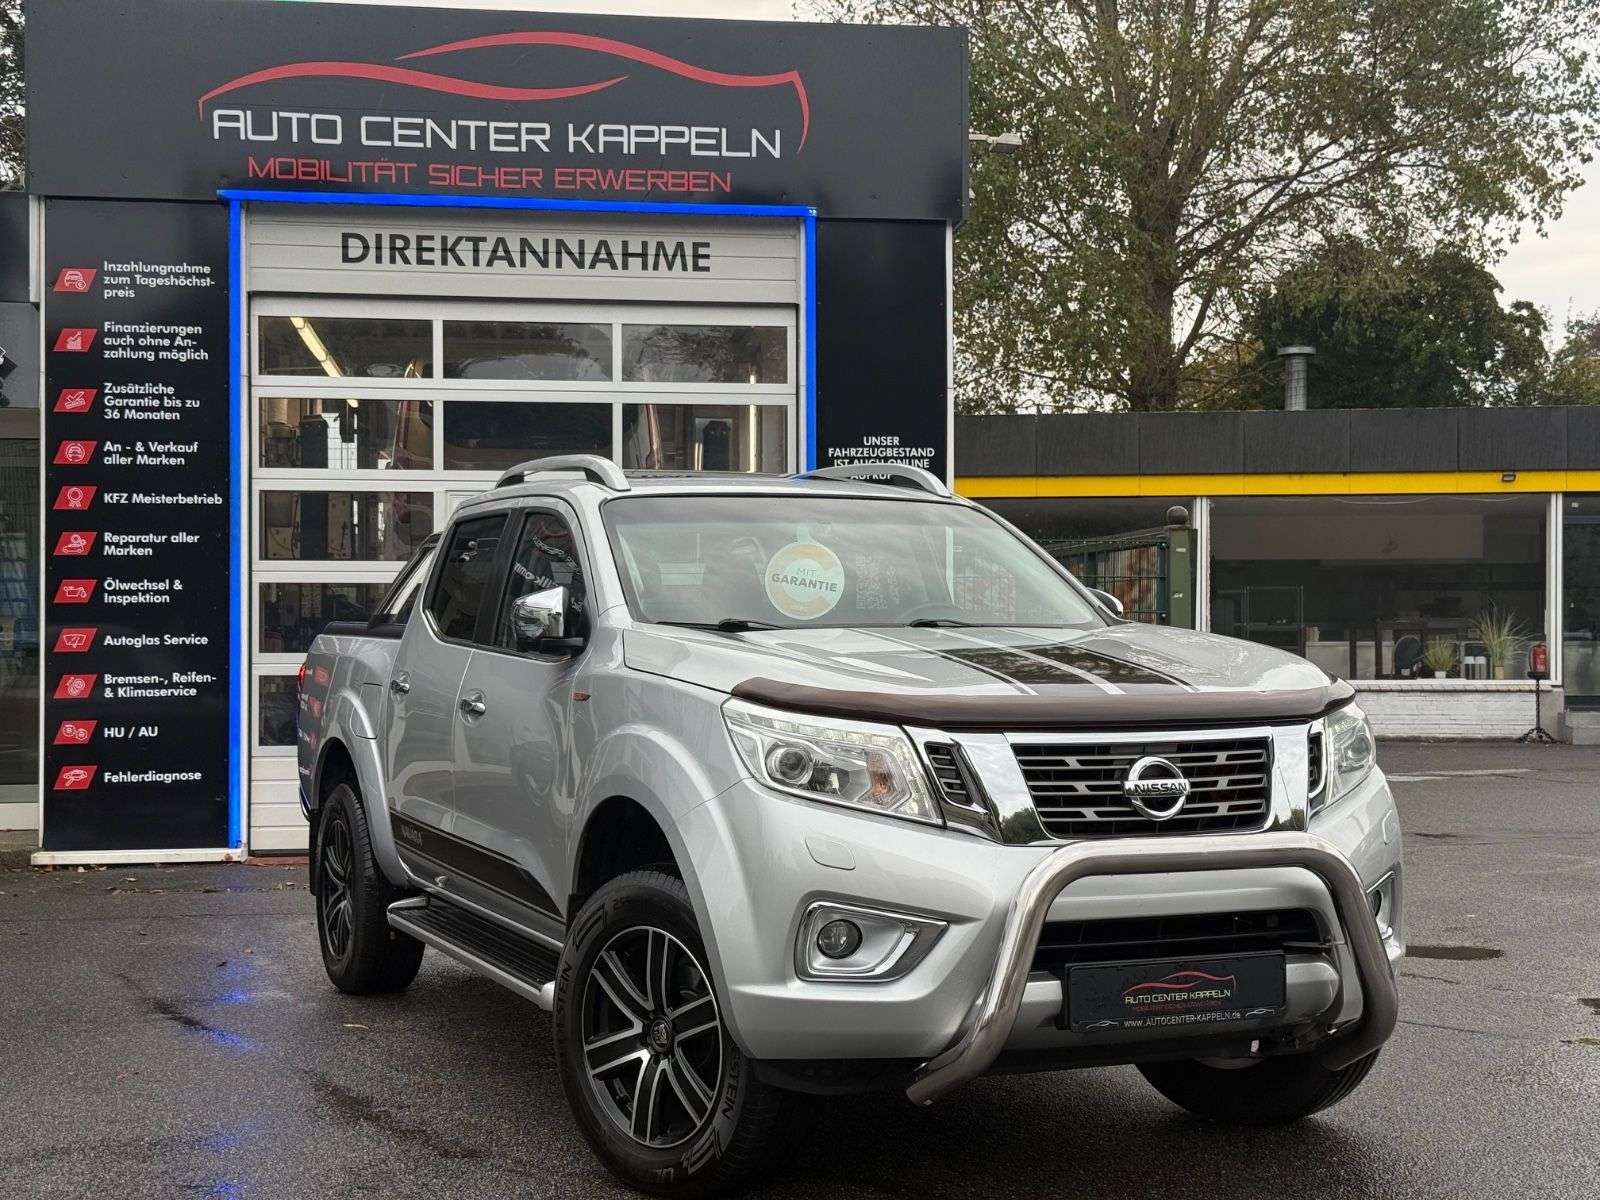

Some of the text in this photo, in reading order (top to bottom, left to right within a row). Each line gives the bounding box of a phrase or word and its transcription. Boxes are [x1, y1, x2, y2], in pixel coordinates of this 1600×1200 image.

[213, 109, 782, 159] AUTO CENTER KAPPELN
[248, 157, 732, 193] MOBILITÄT SICHER ERWERBEN
[341, 231, 711, 273] DIREKTANNAHME
[103, 261, 211, 275] Inzahlungnahme
[103, 275, 215, 287] zum Tageshöchst-
[103, 288, 135, 299] preis
[103, 322, 203, 336] Finanzierungen
[103, 336, 197, 347] auch ohne An-
[103, 349, 209, 362] zahlung möglich
[103, 383, 175, 394] Zusätzliche
[103, 396, 200, 408] Garantie bis zu
[103, 409, 180, 420] 36 Monaten
[135, 442, 145, 452] &
[148, 441, 199, 453] Verkauf
[863, 436, 900, 446] UNSER
[828, 447, 935, 457] FAHRZEUGBESTAND
[103, 454, 185, 465] aller Marken
[834, 459, 849, 467] IST
[103, 493, 223, 505] KFZ Meisterbetrieb
[103, 532, 200, 545] Reparatur aller
[103, 544, 153, 556] Marken
[103, 577, 183, 591] Ölwechsel &
[771, 573, 838, 592] GARANTIE
[103, 592, 170, 605] Inspektion
[103, 634, 209, 648] Autoglas Service
[103, 672, 217, 685] Bremsen-, Reifen-
[103, 686, 197, 698] & Klimaservice
[103, 727, 125, 738] HU
[138, 726, 158, 738] AU
[103, 770, 202, 783] Fehlerdiagnose
[1133, 780, 1188, 794] NISSAN
[1125, 989, 1231, 1004] AUTO CENTER KAPPELN
